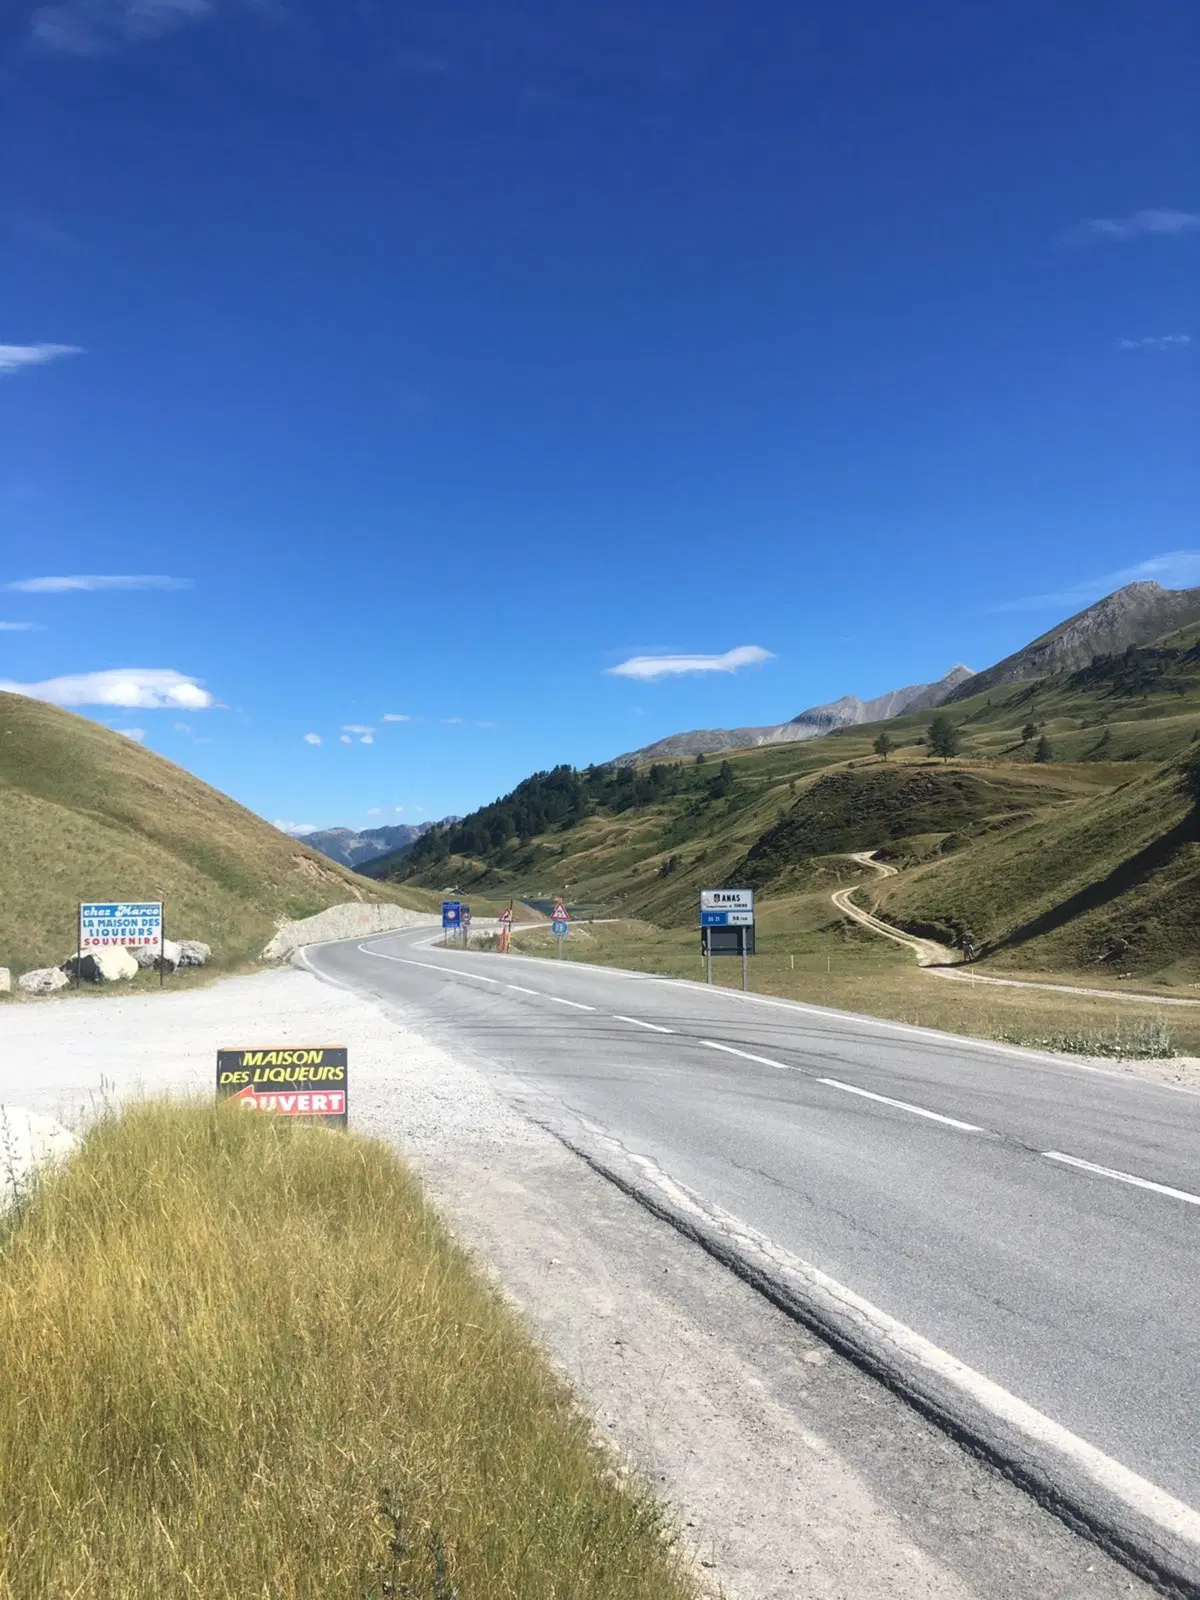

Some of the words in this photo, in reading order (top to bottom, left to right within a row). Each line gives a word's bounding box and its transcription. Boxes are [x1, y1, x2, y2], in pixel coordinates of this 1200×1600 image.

[721, 894, 741, 902] ANAS
[83, 906, 111, 917] chez
[114, 905, 159, 917] Marco
[83, 919, 94, 928] LA
[97, 919, 138, 928] MAISON
[141, 918, 160, 927] DES
[89, 928, 153, 937] LIQUEURS
[84, 937, 159, 946] SOUVENIRS
[242, 1050, 323, 1066] MAISON
[220, 1071, 249, 1084] DES
[253, 1066, 344, 1083] LIQUEURS
[240, 1094, 342, 1112] OUVERT
